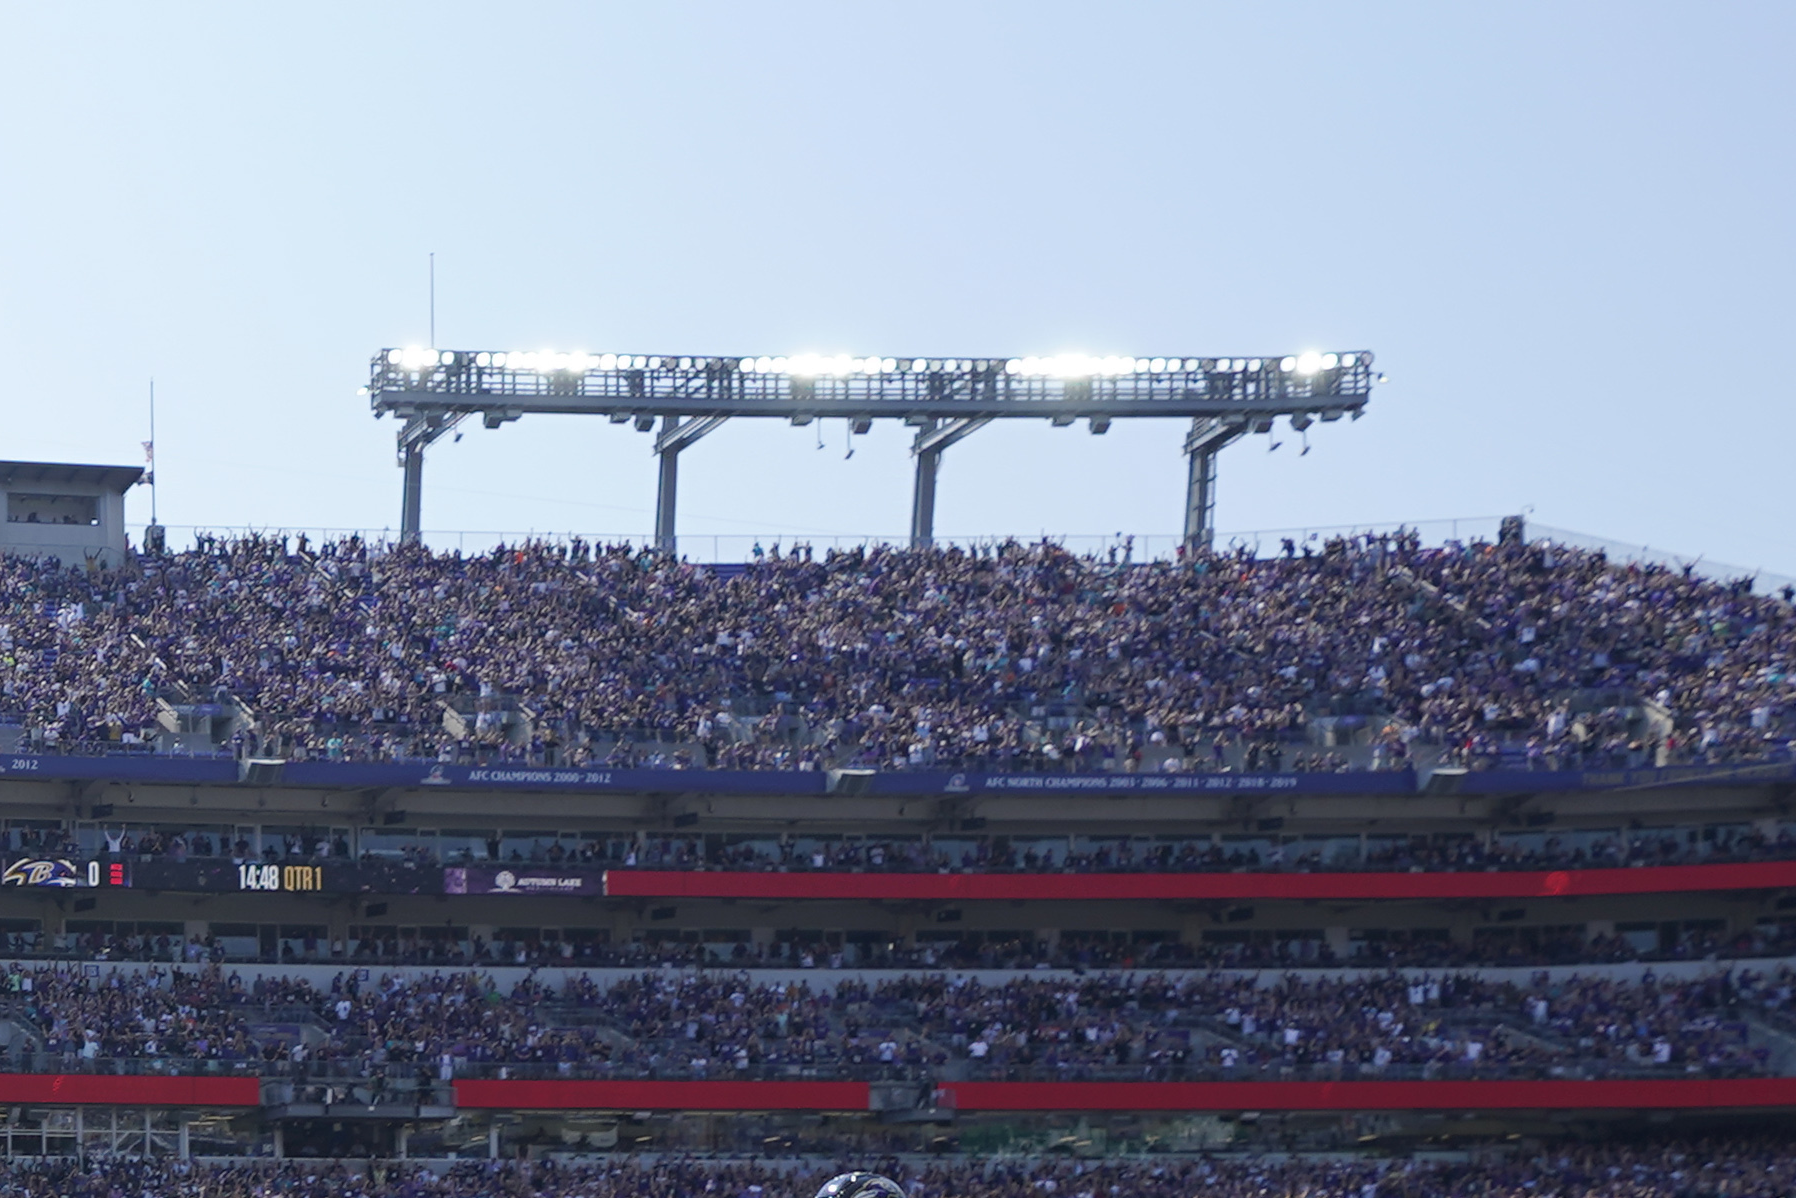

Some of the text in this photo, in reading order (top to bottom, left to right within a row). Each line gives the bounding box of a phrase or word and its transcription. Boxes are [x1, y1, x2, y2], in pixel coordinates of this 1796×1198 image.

[12, 759, 38, 770] 2012
[468, 770, 490, 781] AFC
[491, 771, 552, 782] CHAMPIONS
[985, 777, 1005, 788] AFC
[1007, 777, 1043, 788] NORTH
[1044, 777, 1107, 789] CHAMPIONS
[87, 861, 100, 886] 0
[238, 864, 322, 891] 14:48 QTR 1
[557, 878, 583, 887] LAKE
